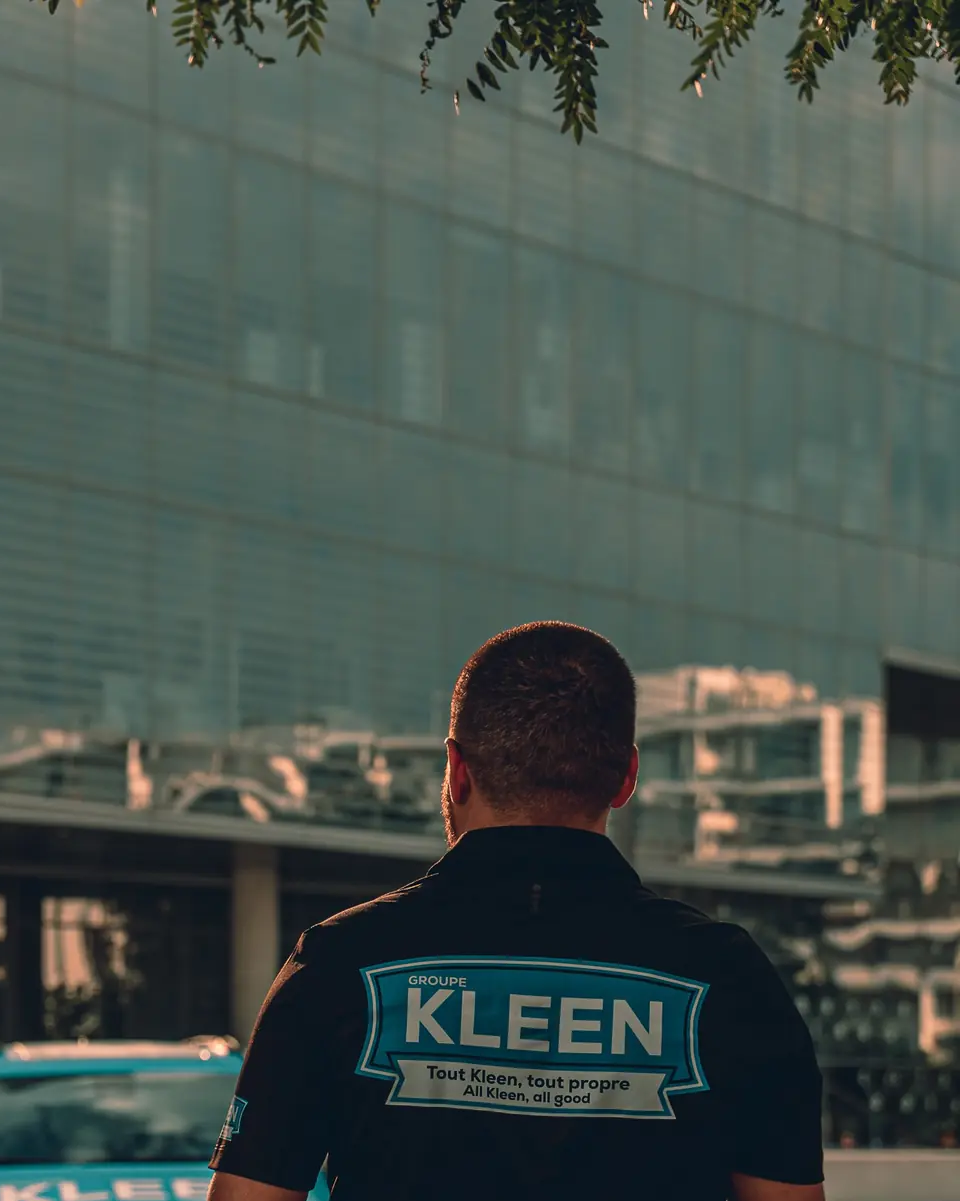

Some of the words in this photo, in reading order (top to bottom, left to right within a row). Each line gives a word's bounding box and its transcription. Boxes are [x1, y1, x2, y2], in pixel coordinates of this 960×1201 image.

[408, 975, 467, 987] GROUPE
[405, 988, 663, 1056] KLEEN
[427, 1065, 466, 1081] Tout
[470, 1068, 522, 1088] Kleen,
[527, 1074, 564, 1089] tout
[568, 1077, 631, 1094] propre
[463, 1084, 483, 1097] All
[486, 1086, 530, 1103] Kleen,
[533, 1092, 551, 1103] all
[554, 1092, 591, 1107] good
